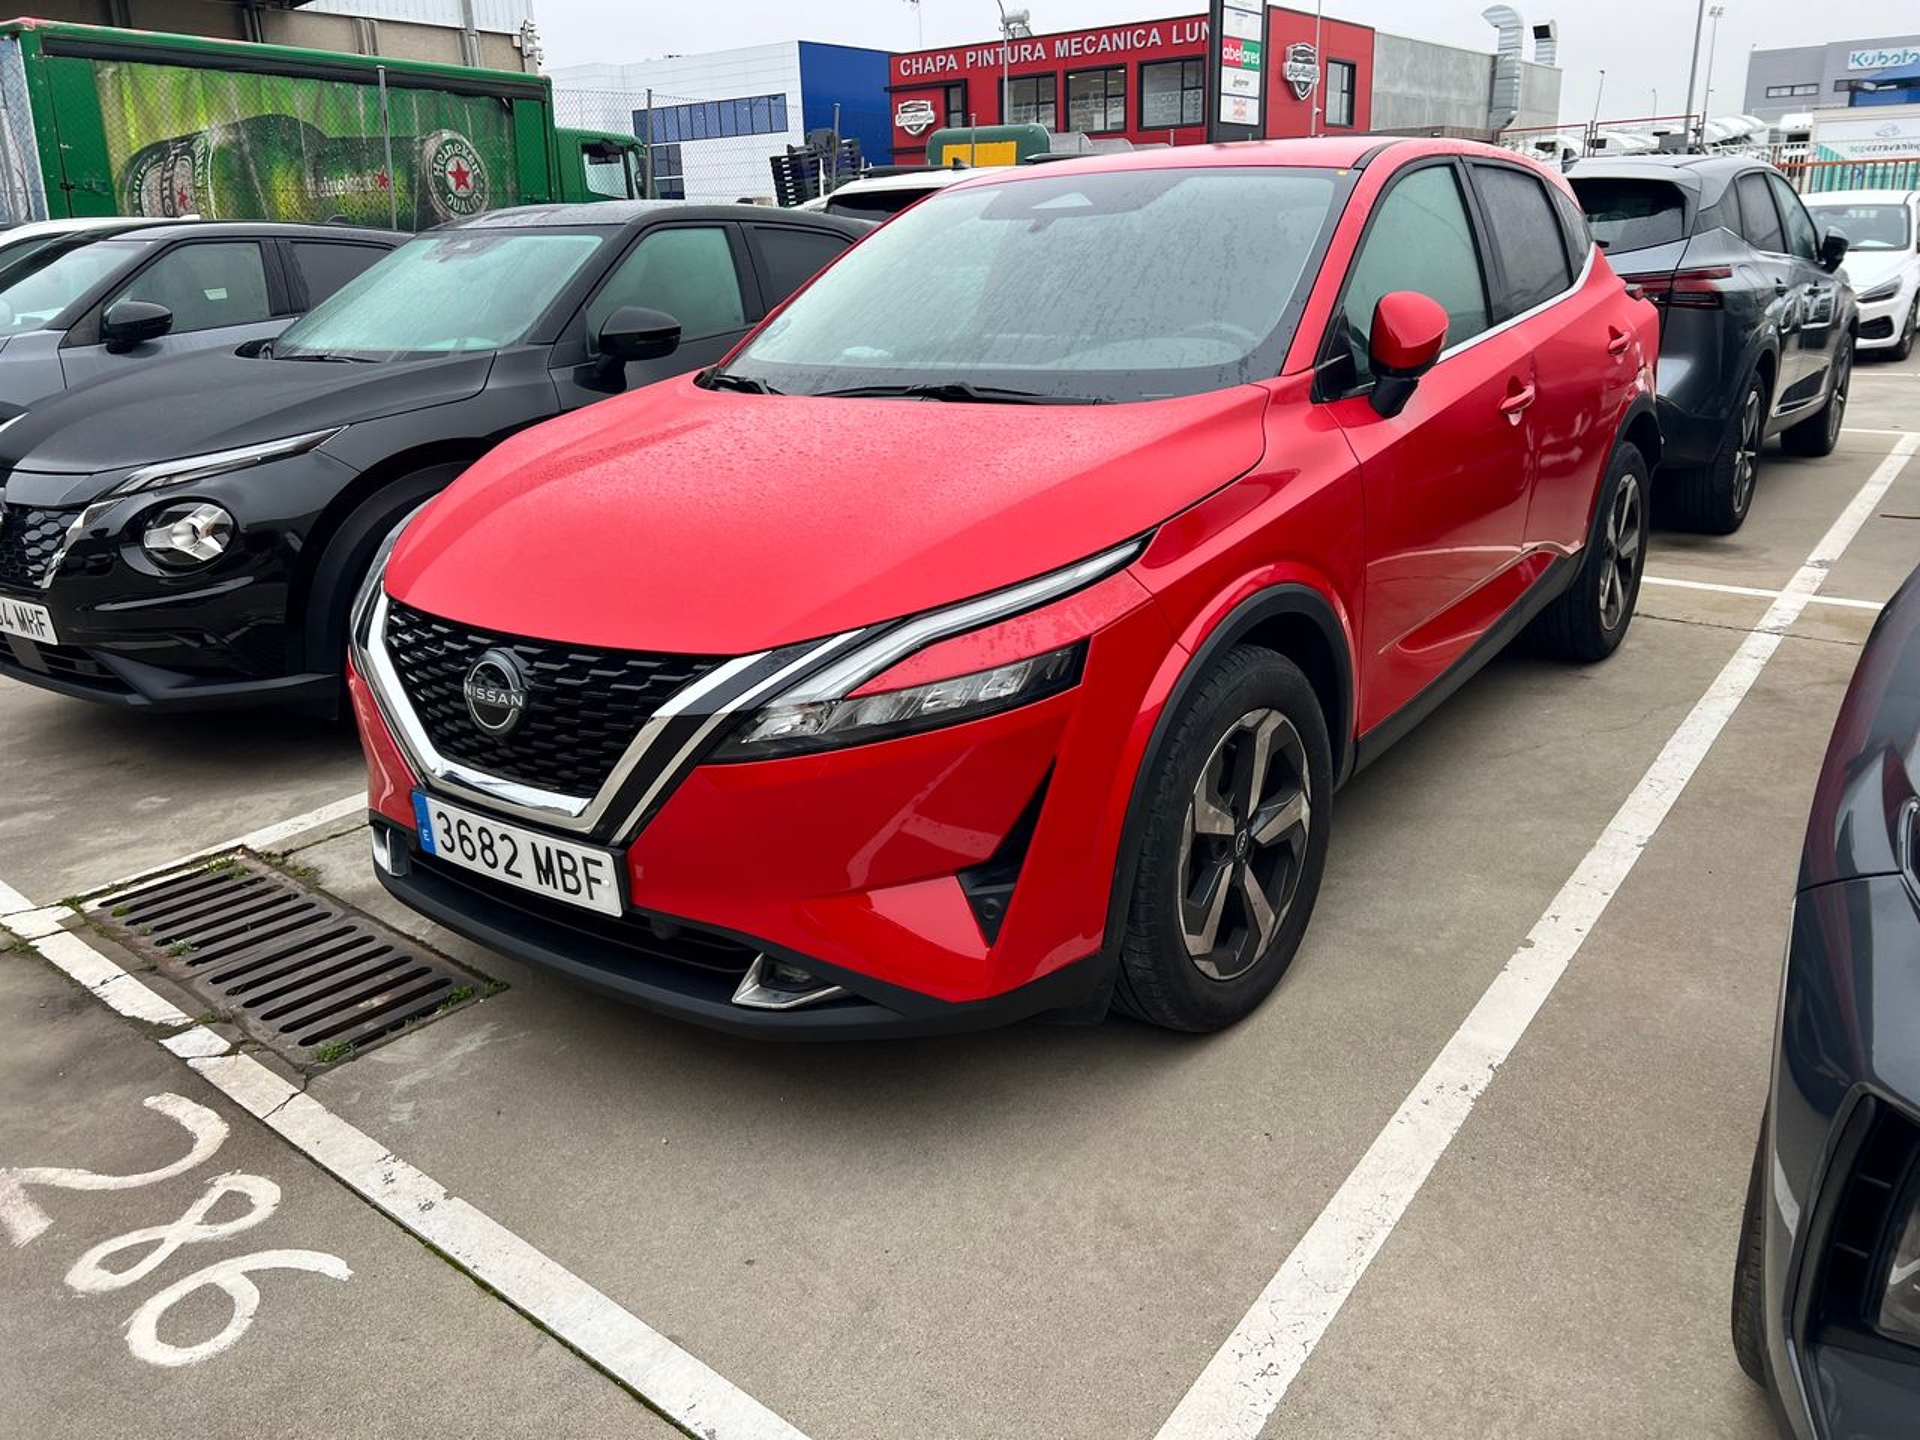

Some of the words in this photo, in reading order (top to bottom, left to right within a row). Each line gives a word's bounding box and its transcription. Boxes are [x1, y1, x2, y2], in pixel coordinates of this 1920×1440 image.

[899, 55, 958, 77] CHAPA
[965, 41, 1046, 70] PINTURA
[1054, 27, 1163, 59] MECANICA
[1222, 43, 1260, 65] abelares
[1851, 48, 1920, 67] Kubota
[432, 142, 481, 178] Heineken
[13, 604, 46, 637] MHF
[464, 679, 524, 708] NISSAN
[436, 811, 523, 879] 3682
[531, 840, 603, 901] MBF
[0, 1091, 354, 1367] 286
